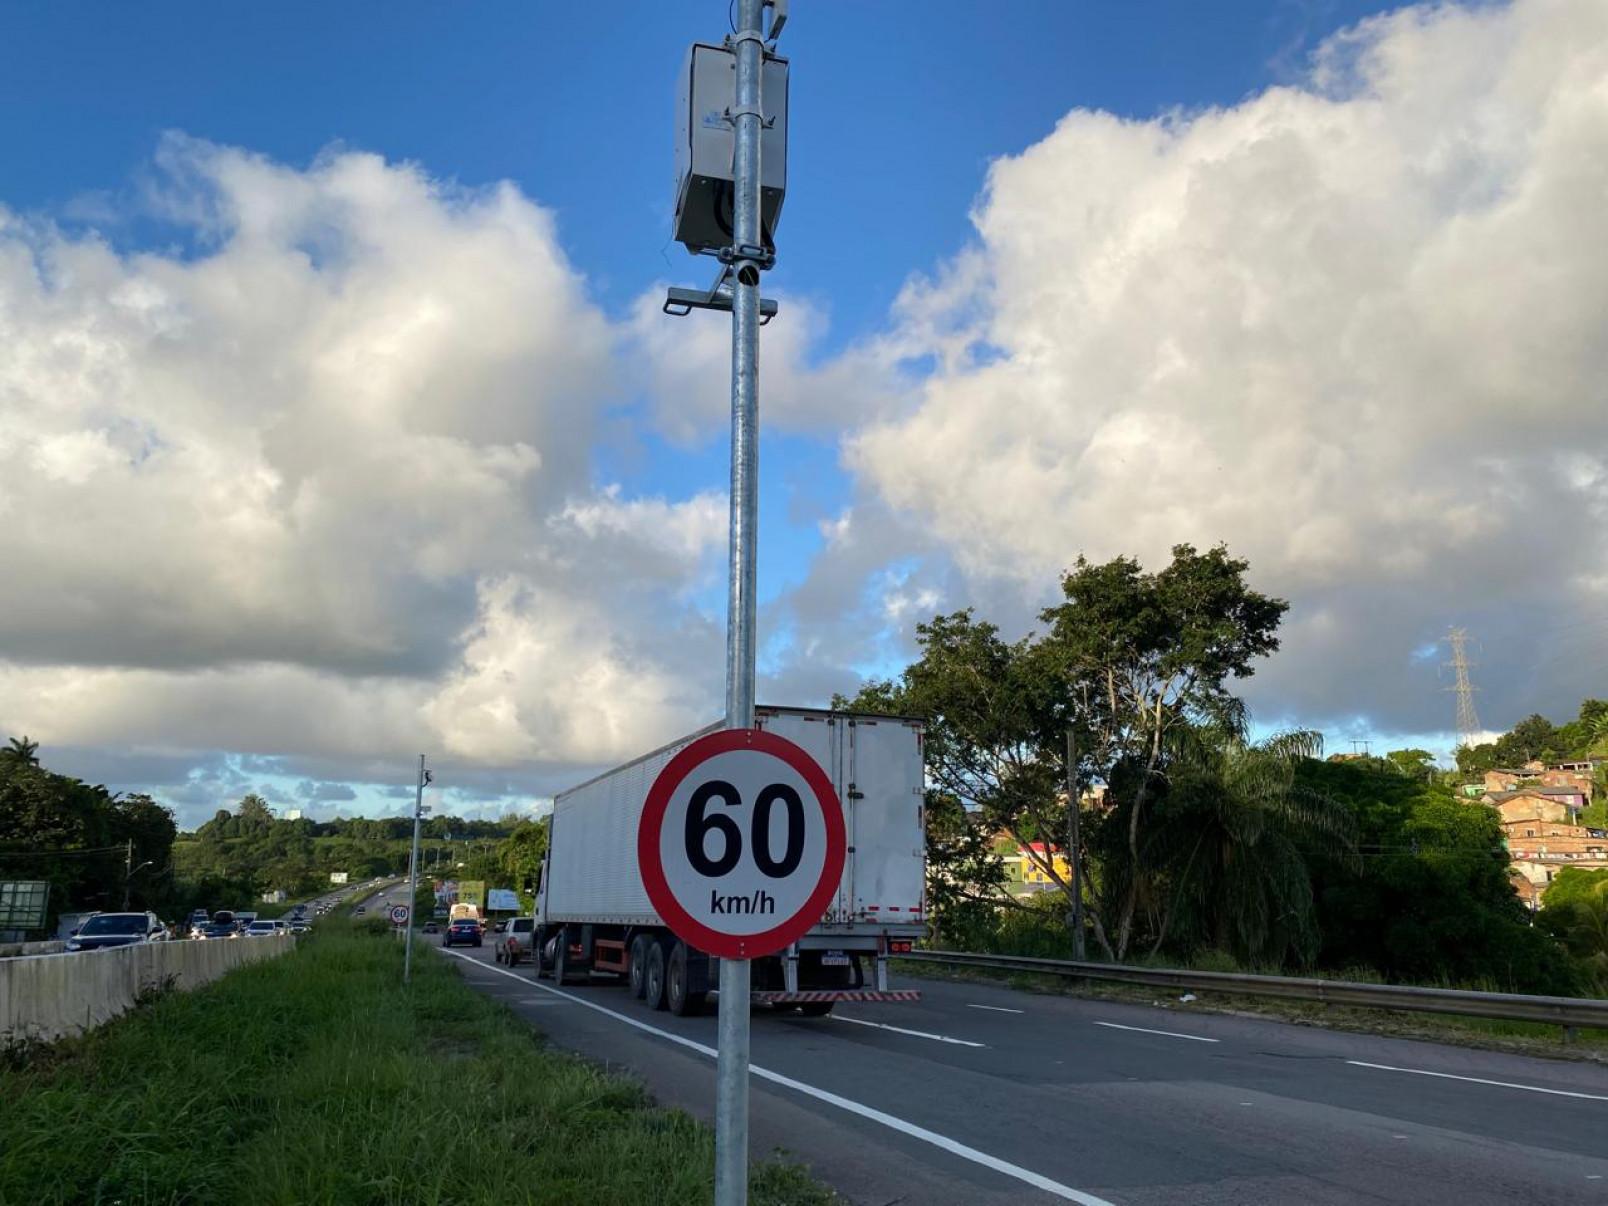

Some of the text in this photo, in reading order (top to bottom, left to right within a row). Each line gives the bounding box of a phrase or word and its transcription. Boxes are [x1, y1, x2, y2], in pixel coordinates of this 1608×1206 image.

[685, 780, 805, 878] 60
[394, 909, 406, 918] 60
[711, 890, 775, 914] km/h
